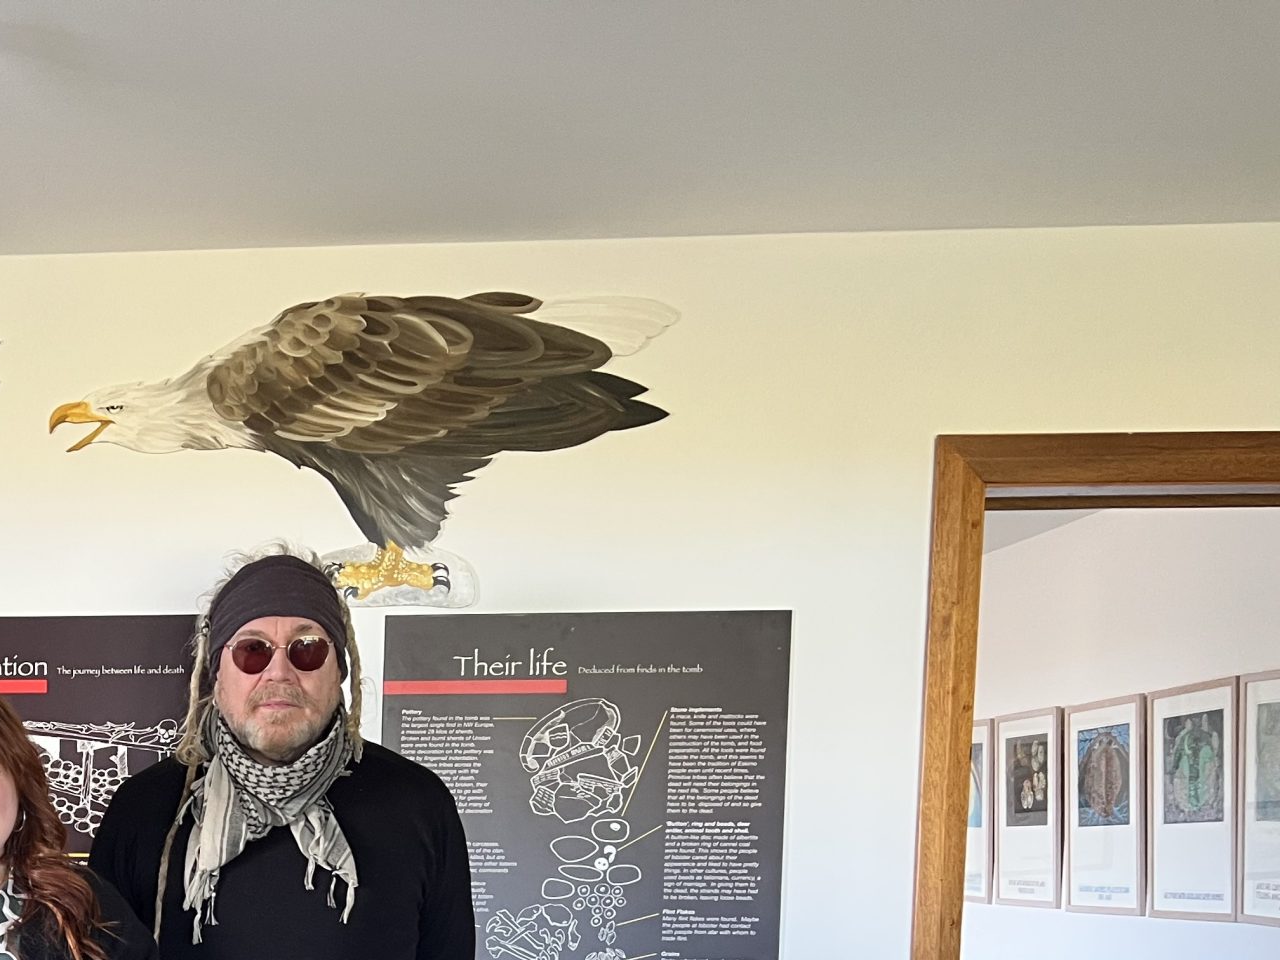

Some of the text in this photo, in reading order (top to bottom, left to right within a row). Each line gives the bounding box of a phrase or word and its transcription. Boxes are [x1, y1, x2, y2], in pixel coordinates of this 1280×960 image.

[453, 647, 568, 676] Their life
[56, 665, 185, 679] The journey between life and death
[578, 665, 615, 674] Deduced
[616, 665, 635, 674] from
[636, 665, 657, 673] finds
[667, 664, 681, 673] the
[682, 664, 703, 673] tomb
